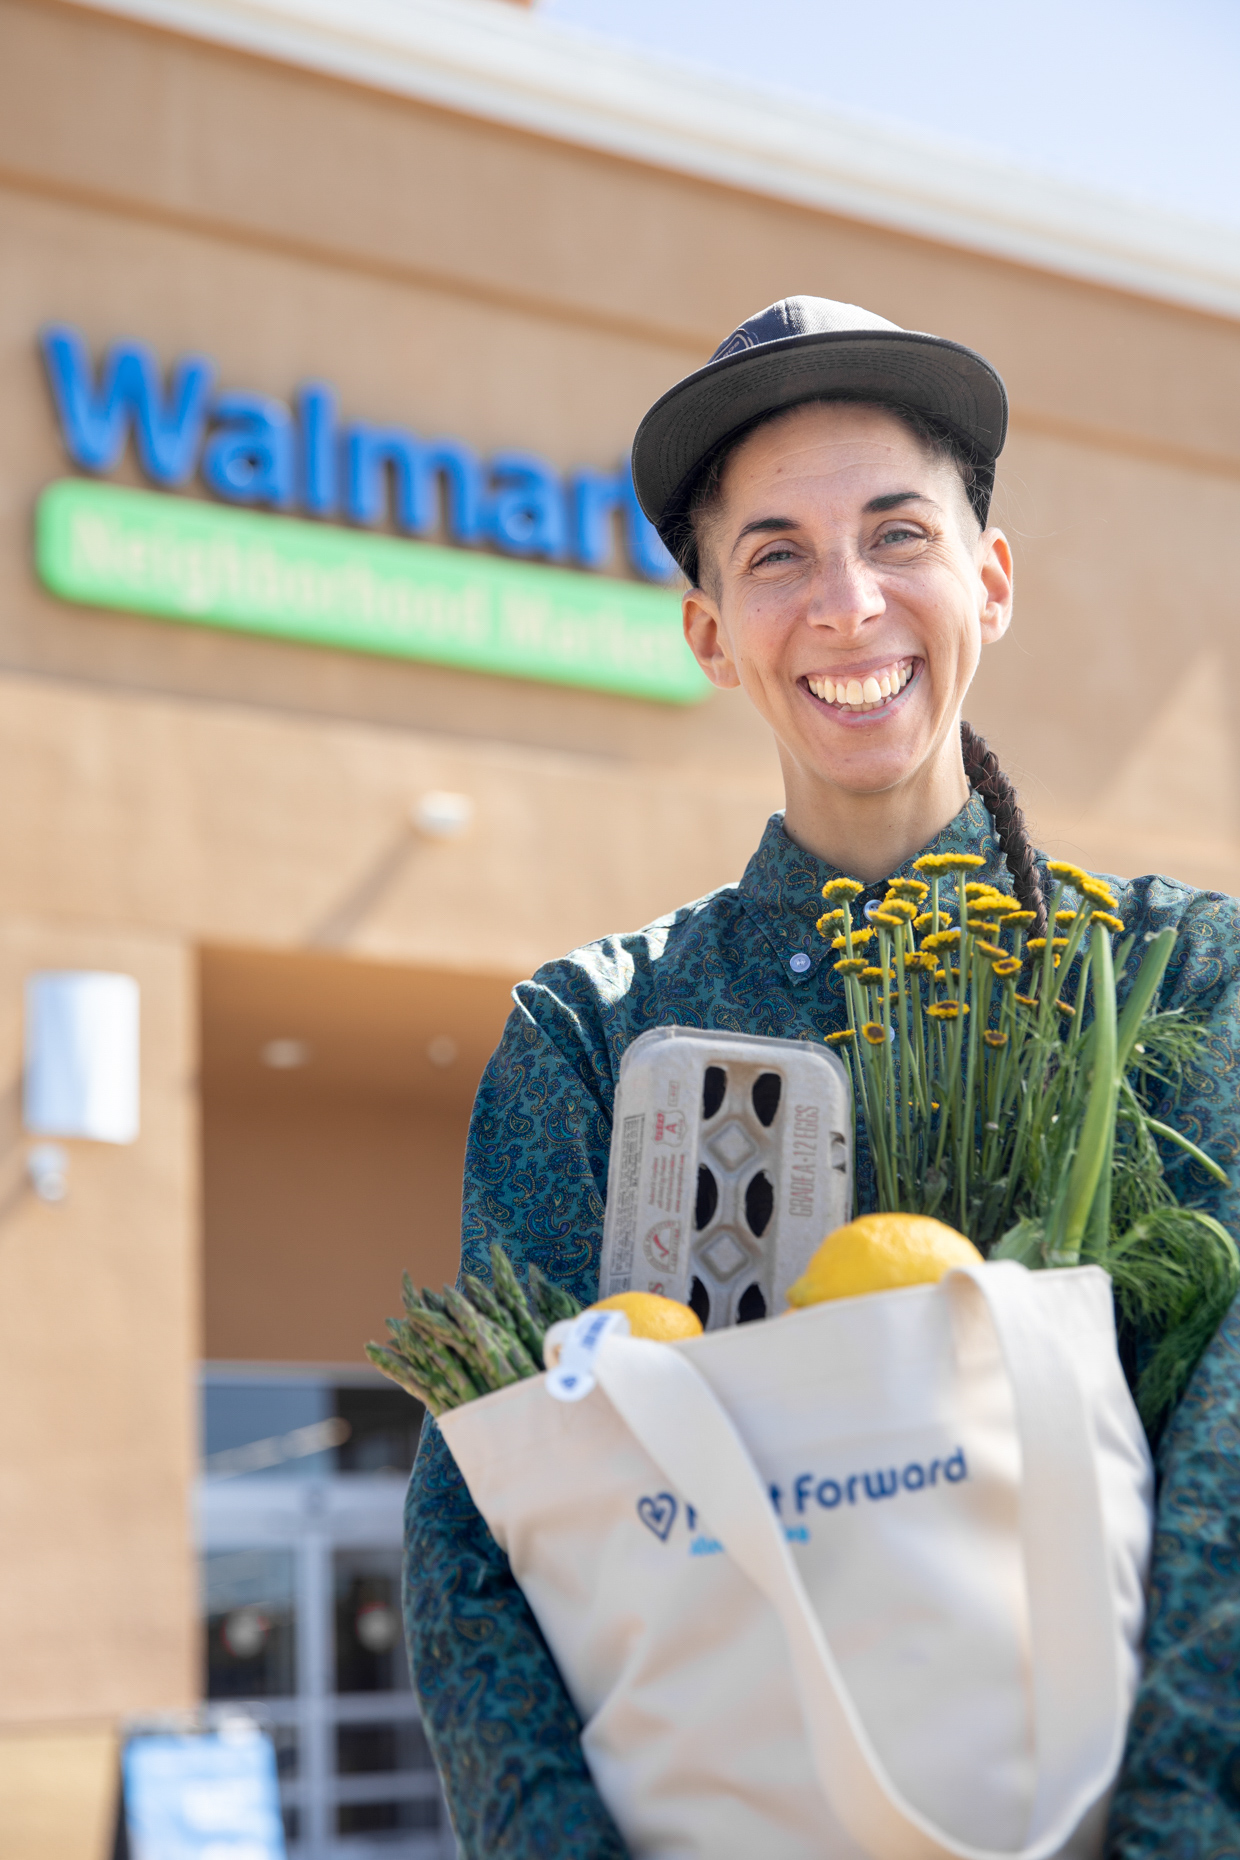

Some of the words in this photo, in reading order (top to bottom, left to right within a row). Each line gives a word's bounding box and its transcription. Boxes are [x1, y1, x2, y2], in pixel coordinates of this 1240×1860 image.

[42, 323, 682, 582] Walmart
[793, 1104, 820, 1139] EGGS
[792, 1141, 817, 1156] 12
[792, 1163, 816, 1175] A
[788, 1174, 815, 1218] GRADE
